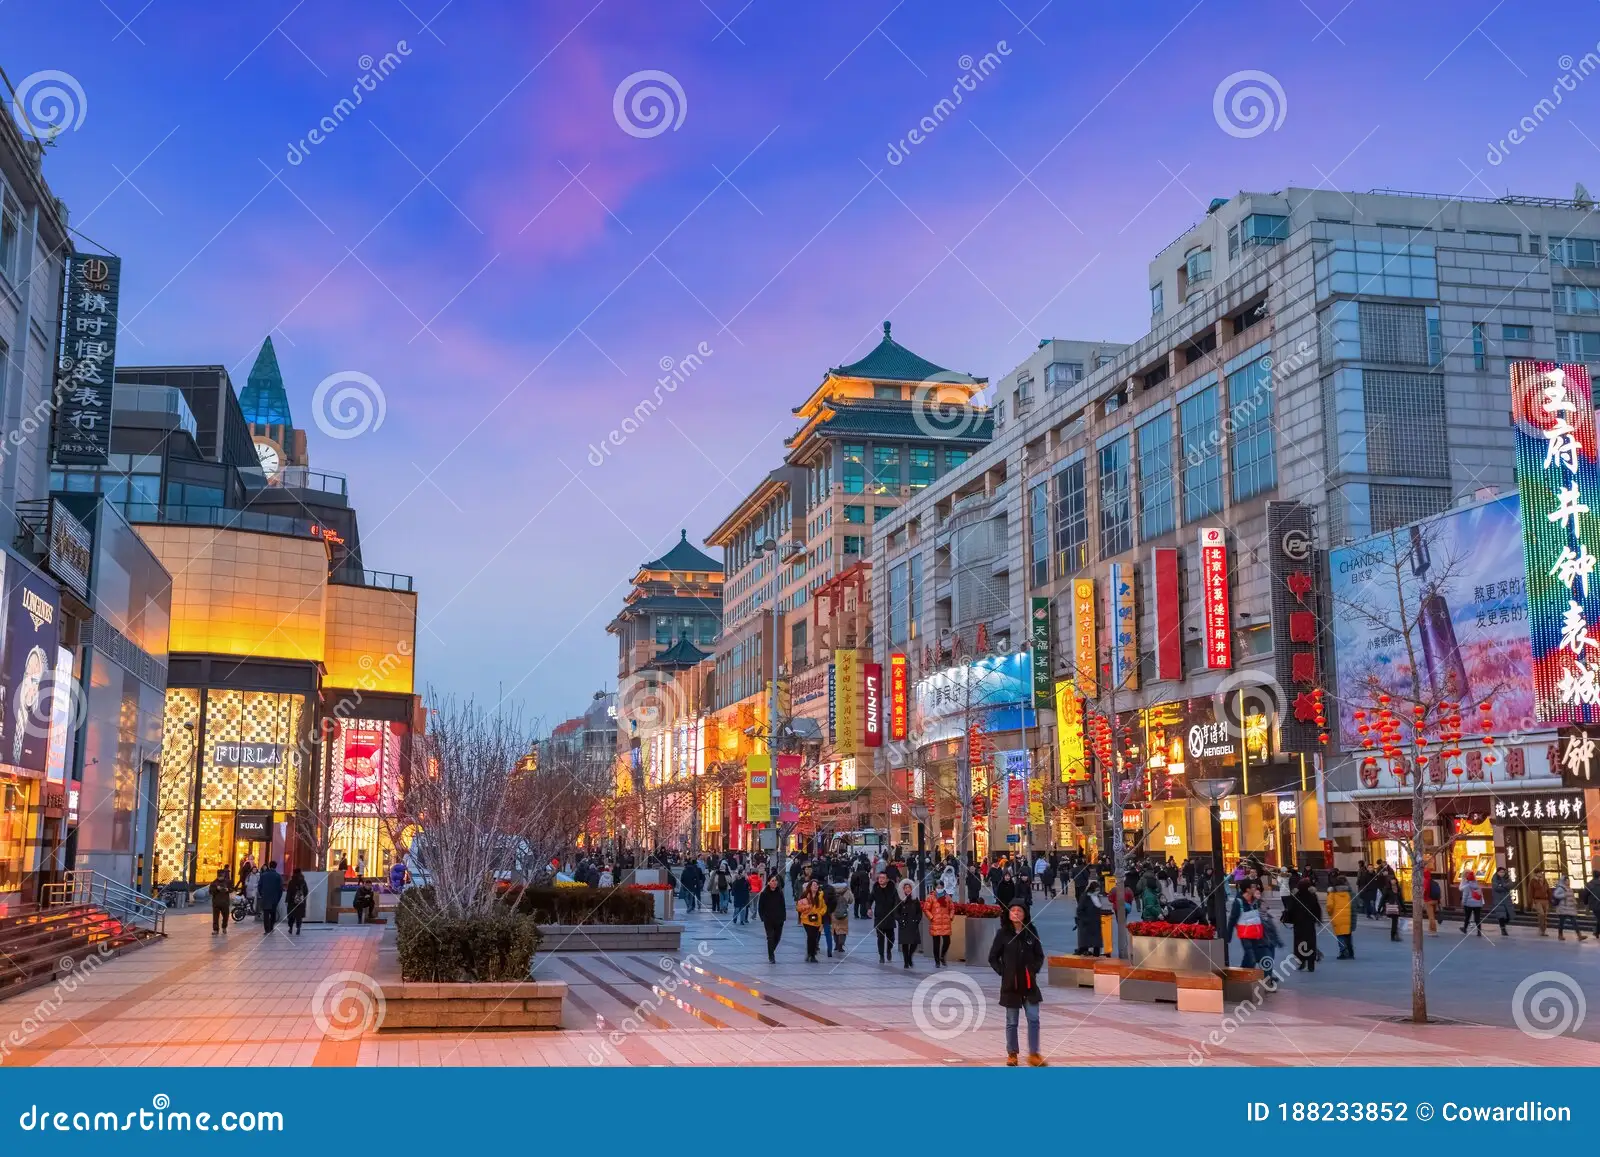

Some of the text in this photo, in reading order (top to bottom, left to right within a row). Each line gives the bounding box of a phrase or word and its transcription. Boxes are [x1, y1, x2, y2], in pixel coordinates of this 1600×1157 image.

[1340, 551, 1384, 574] CHANDO
[22, 587, 54, 624] LONGINES
[1211, 548, 1227, 665] 北京全聚德王府井店
[1035, 625, 1048, 683] 天福茗茶
[867, 676, 877, 733] LI-NING
[215, 745, 281, 764] FURLA
[1203, 745, 1234, 757] HENGDELI
[1561, 731, 1595, 781] 钟
[1495, 797, 1583, 819] 瑞士名表维修中
[240, 822, 264, 830] FURLA
